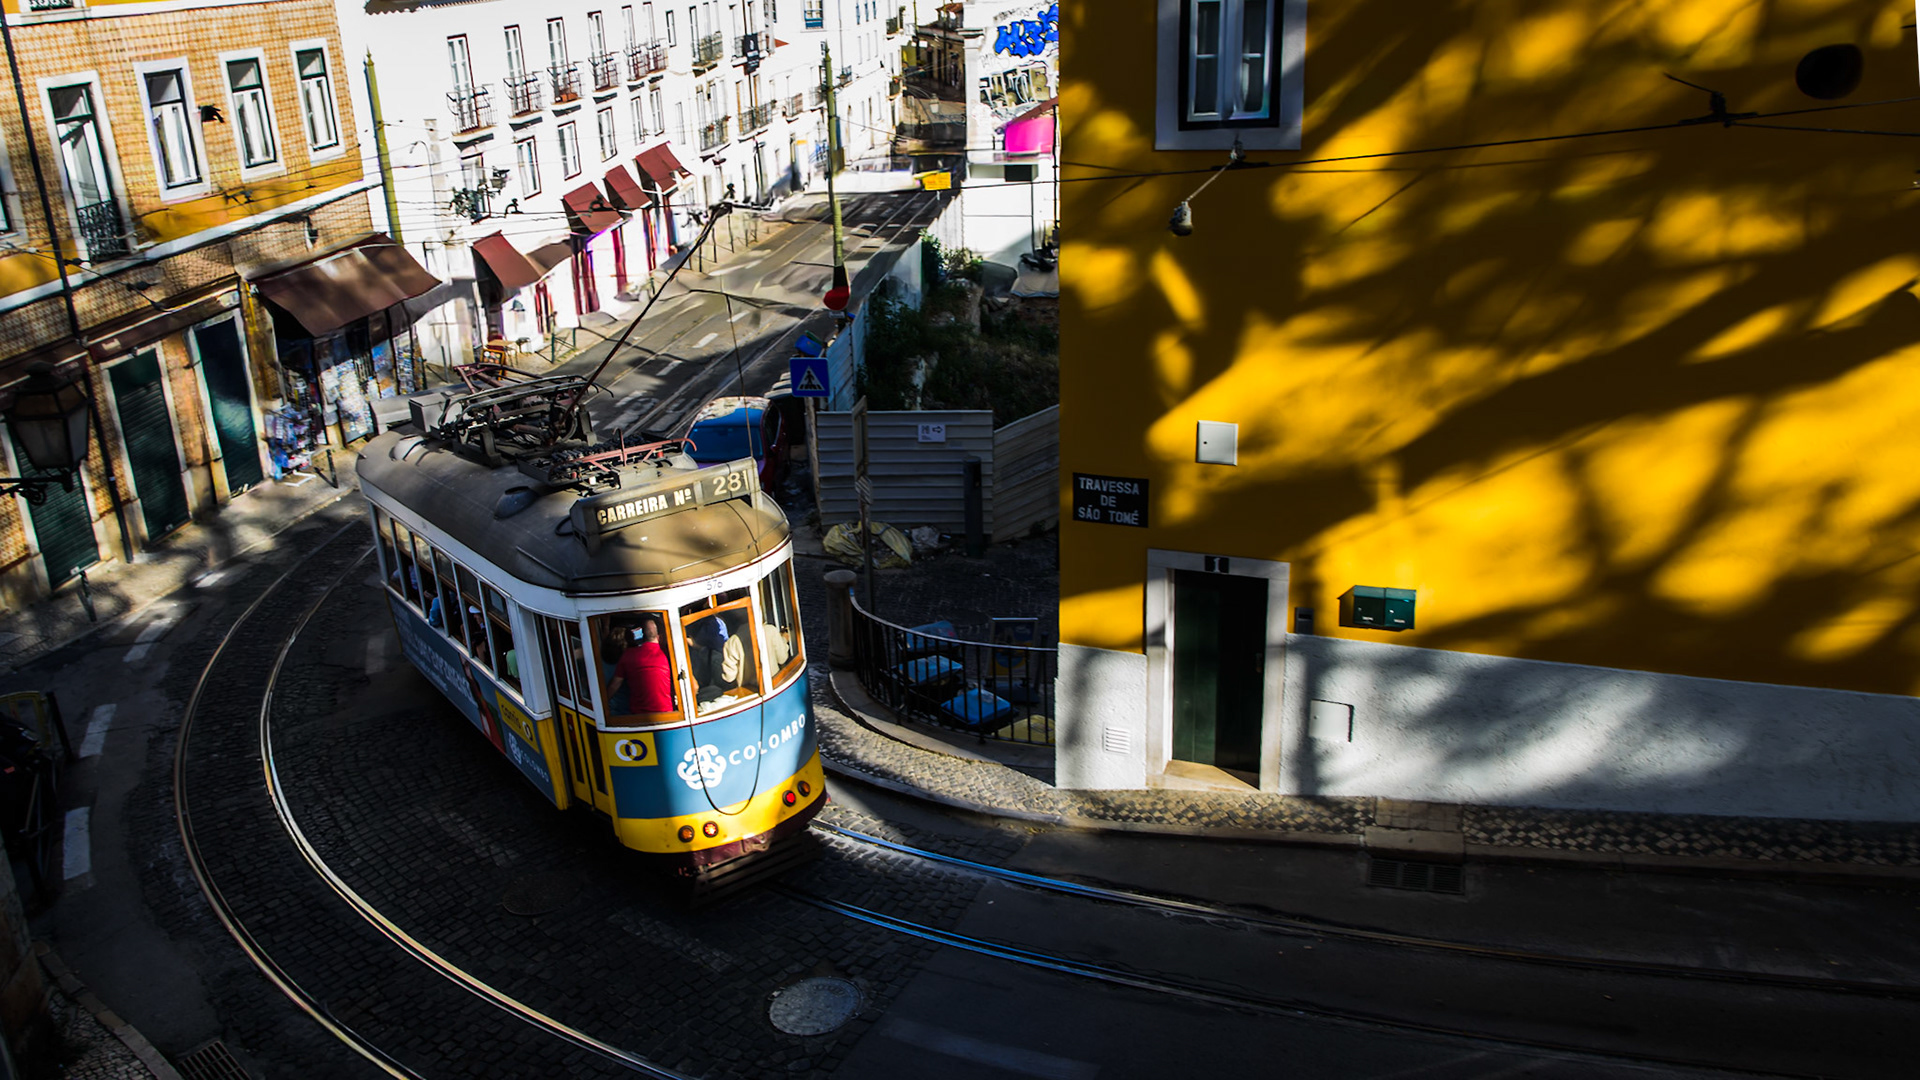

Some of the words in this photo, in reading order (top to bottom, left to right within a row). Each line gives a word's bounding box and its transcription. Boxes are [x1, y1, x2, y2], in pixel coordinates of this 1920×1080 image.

[1078, 476, 1140, 495] TRAVESSA
[596, 494, 669, 526] CARREIRA
[1100, 495, 1117, 508] DE
[1078, 504, 1101, 521] SÃO
[1108, 509, 1140, 526] TOMÉ
[728, 713, 806, 766] COLOMBO
